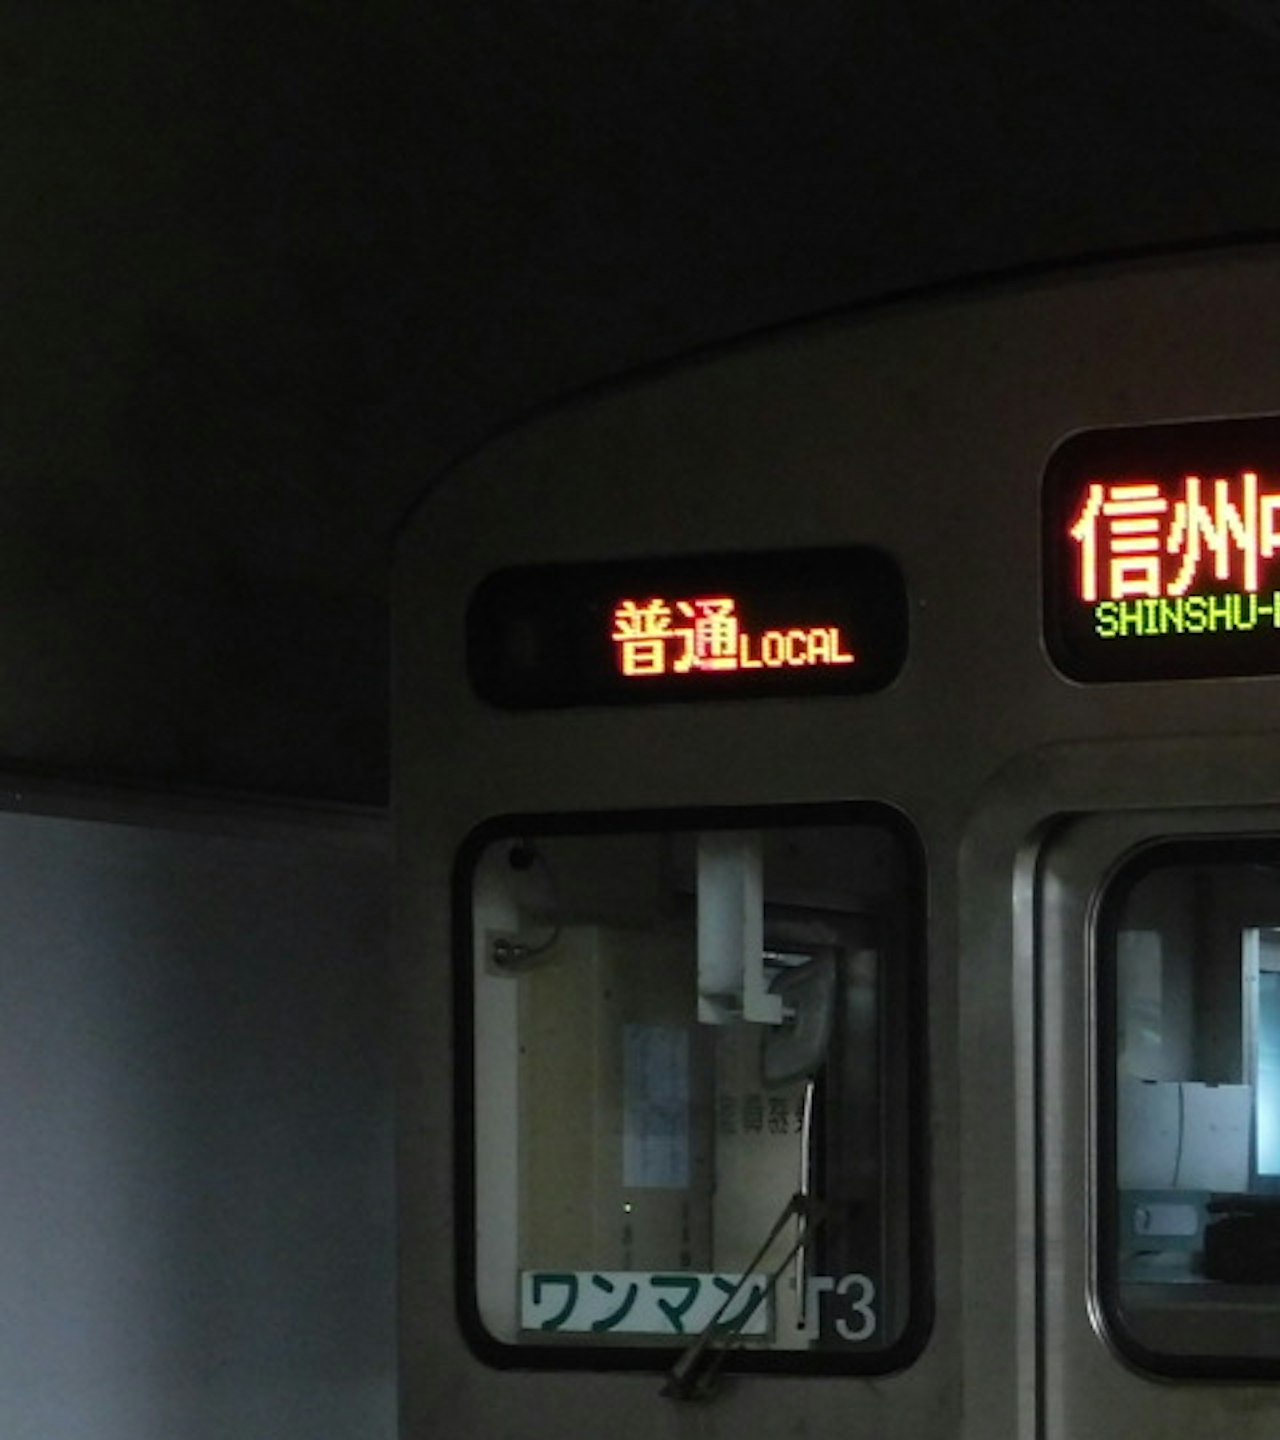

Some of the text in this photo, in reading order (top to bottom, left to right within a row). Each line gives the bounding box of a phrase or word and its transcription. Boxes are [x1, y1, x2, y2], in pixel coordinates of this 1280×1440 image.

[611, 597, 855, 677] 普通 LOCAL
[532, 1273, 764, 1334] ワンマン
